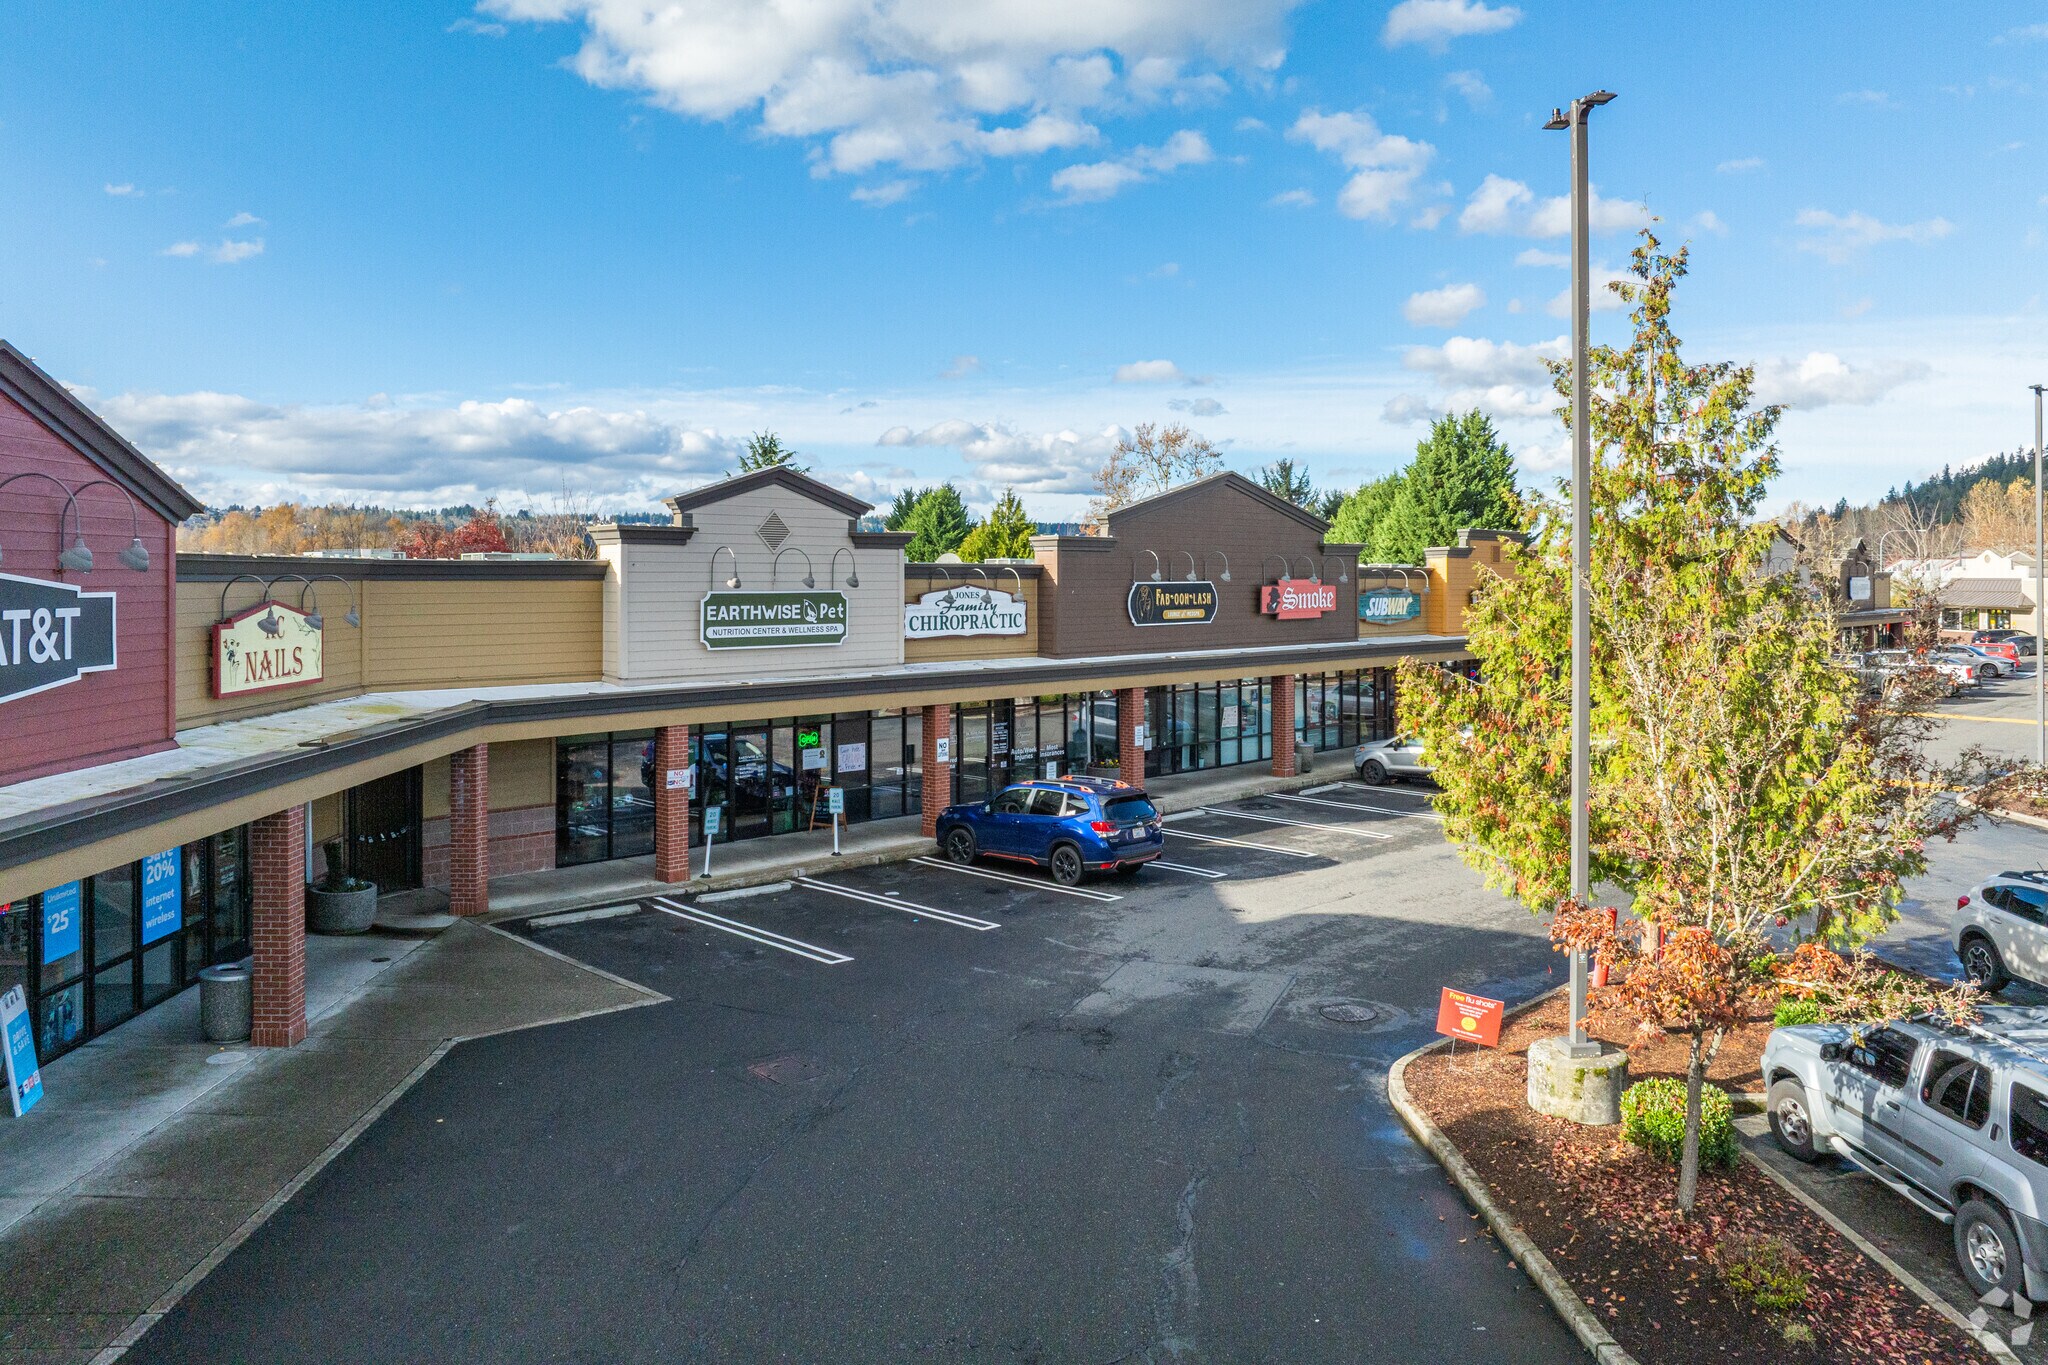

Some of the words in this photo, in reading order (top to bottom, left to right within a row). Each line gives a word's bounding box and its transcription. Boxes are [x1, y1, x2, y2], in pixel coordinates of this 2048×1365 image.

[955, 591, 980, 600] JONES
[1282, 587, 1334, 611] Smoke
[706, 604, 801, 621] EARTHWISE
[820, 602, 844, 619] Pet
[1366, 596, 1413, 617] SUBWAY
[712, 627, 751, 636] NUTRITION
[752, 626, 780, 635] CENTER
[781, 626, 787, 634] &
[788, 625, 824, 634] WELLNESS
[825, 625, 838, 633] SPA
[909, 612, 1023, 632] CHIROPRACTIC
[0, 607, 81, 666] T&T
[244, 646, 303, 684] NAILS
[1010, 746, 1038, 755] Auto/Work
[1014, 754, 1034, 762] Injuries
[1039, 750, 1065, 758] Insurances
[146, 858, 175, 885] 20%
[47, 886, 77, 904] Unlimited
[145, 888, 175, 907] internet
[47, 909, 69, 934] $25
[145, 909, 175, 929] wireless
[1449, 991, 1465, 1002] Free
[1465, 996, 1475, 1004] flu
